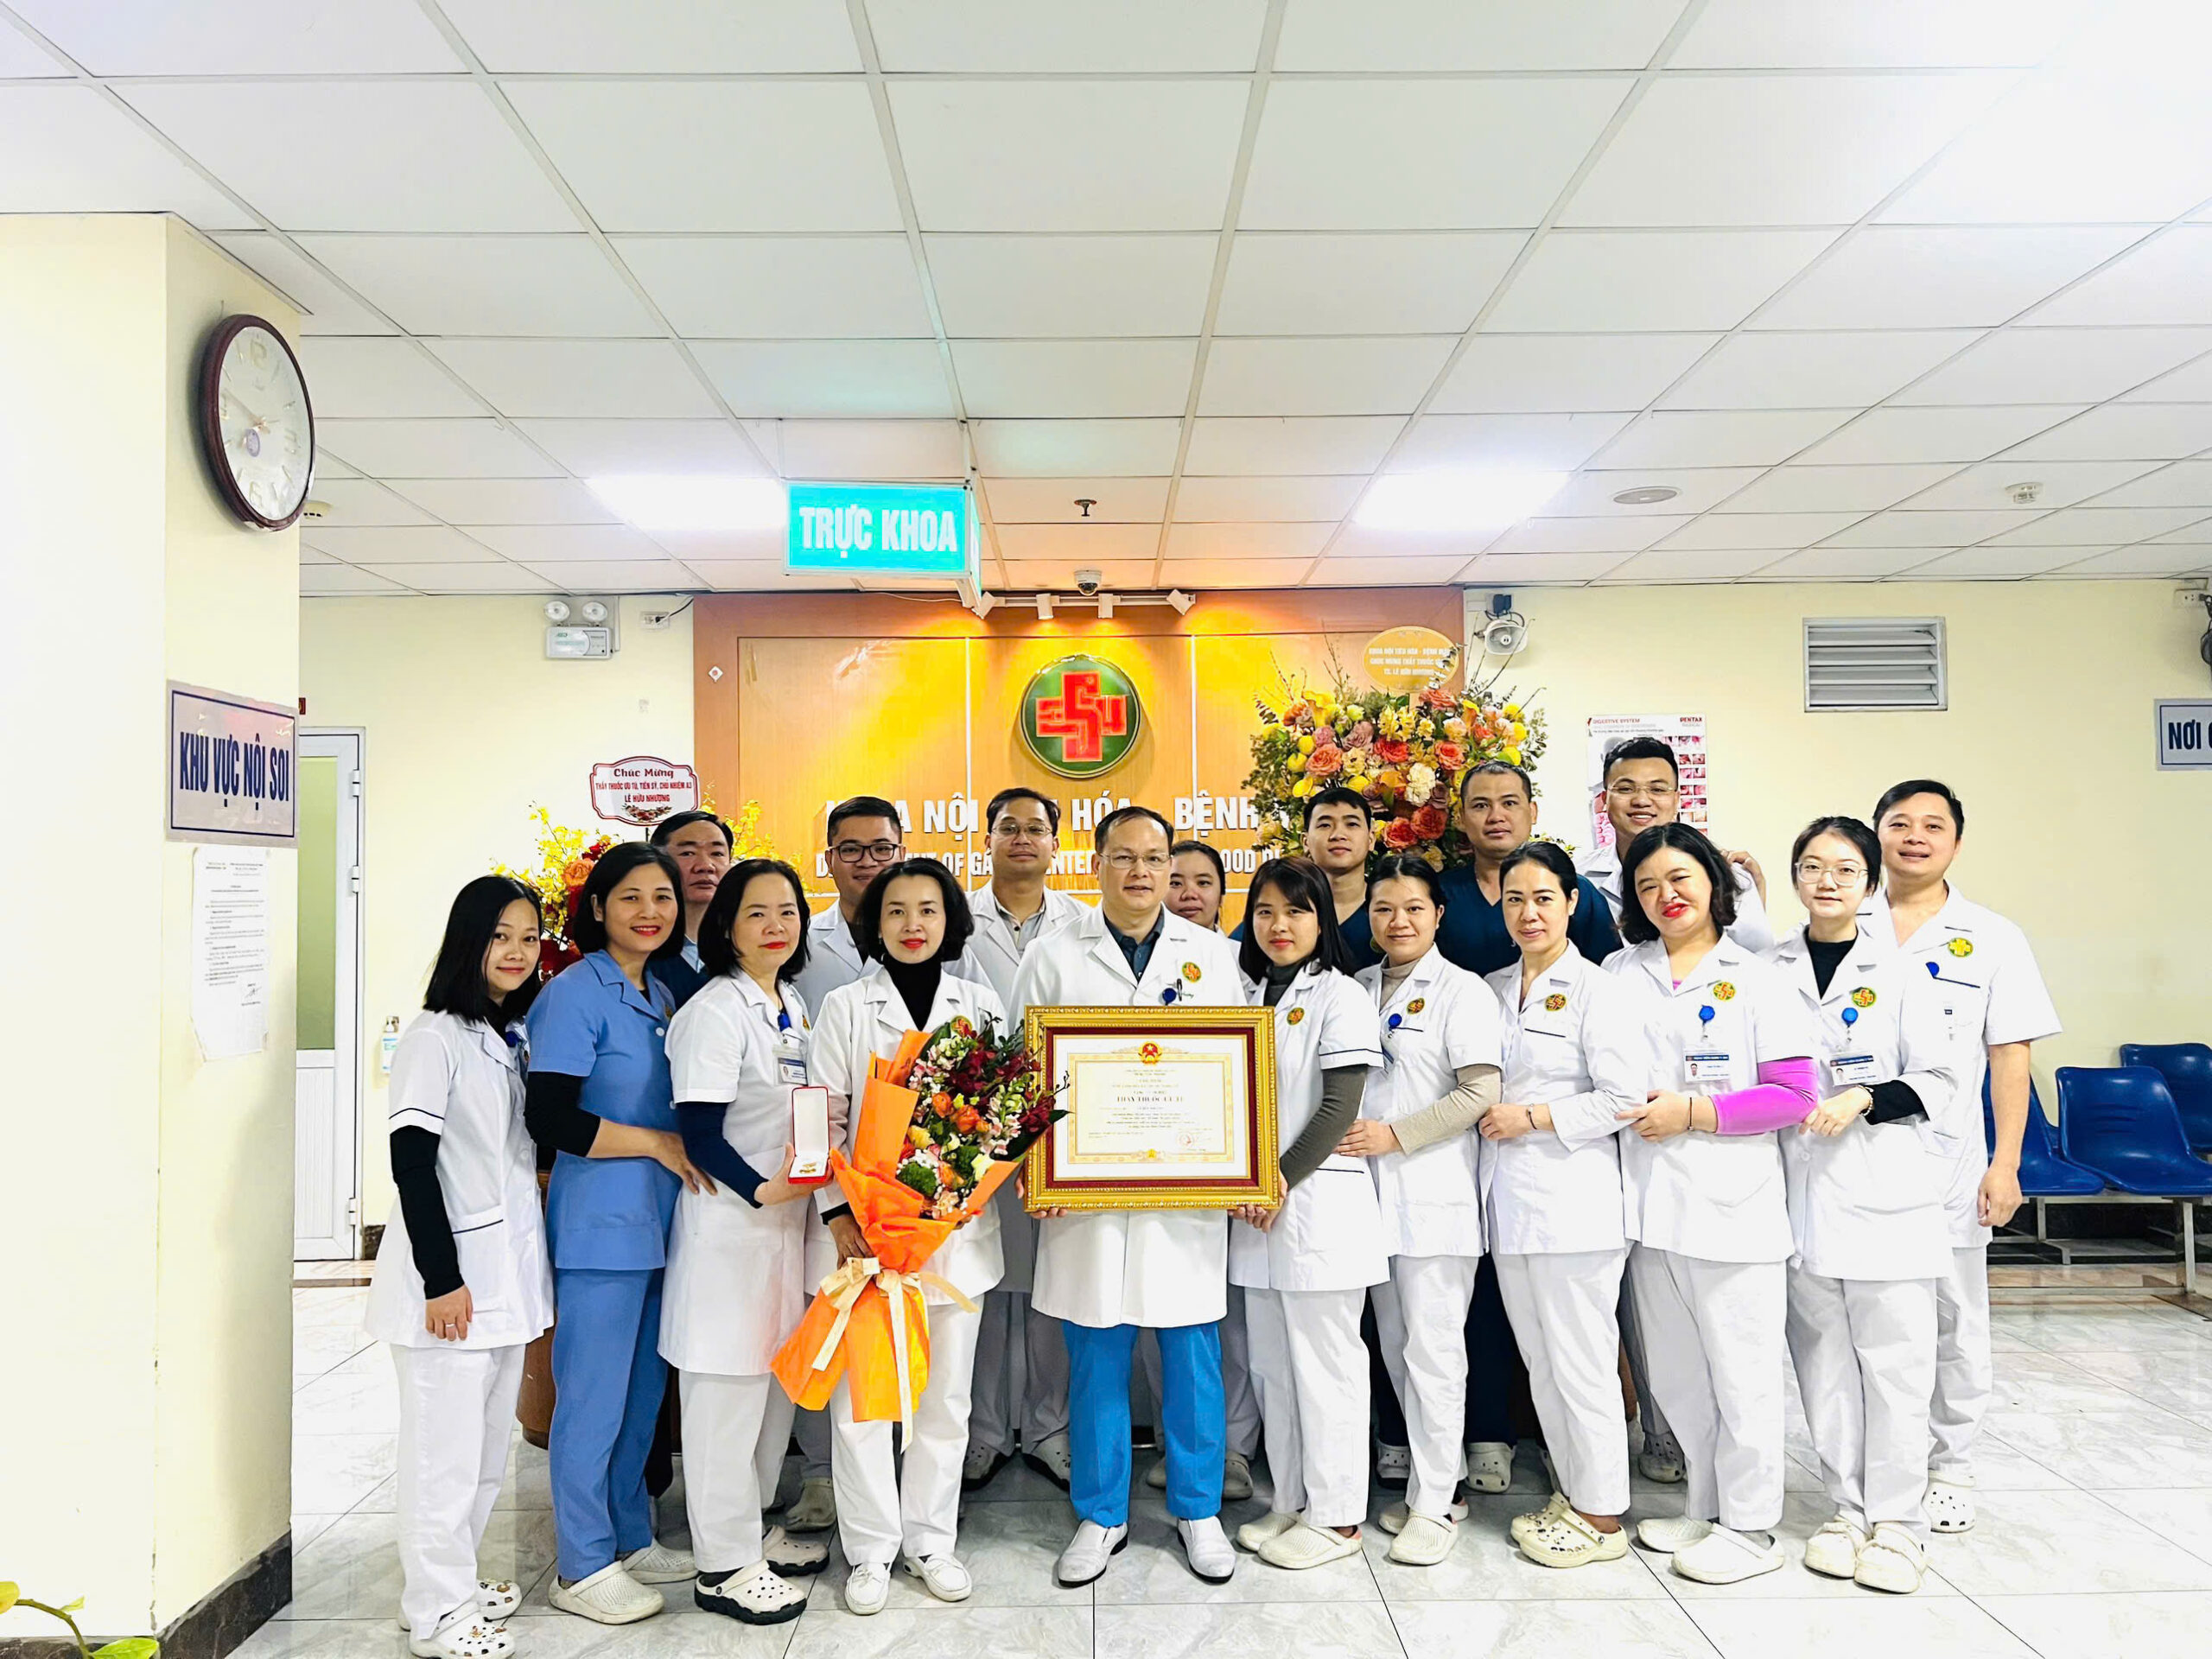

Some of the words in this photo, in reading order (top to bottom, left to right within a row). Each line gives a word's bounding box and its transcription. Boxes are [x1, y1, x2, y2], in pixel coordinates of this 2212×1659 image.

[798, 504, 873, 559] TRỰC
[881, 509, 958, 552] KHOA
[2168, 719, 2202, 750] NƠI
[180, 732, 209, 792] KHU
[213, 734, 239, 807] VỰC
[244, 733, 265, 810] NỘI
[270, 747, 289, 802] SOI
[613, 768, 640, 777] Chúc
[645, 768, 673, 779] Mừng
[924, 792, 978, 841] NỘI
[1174, 789, 1259, 836] BỆNH
[942, 852, 965, 877] OF
